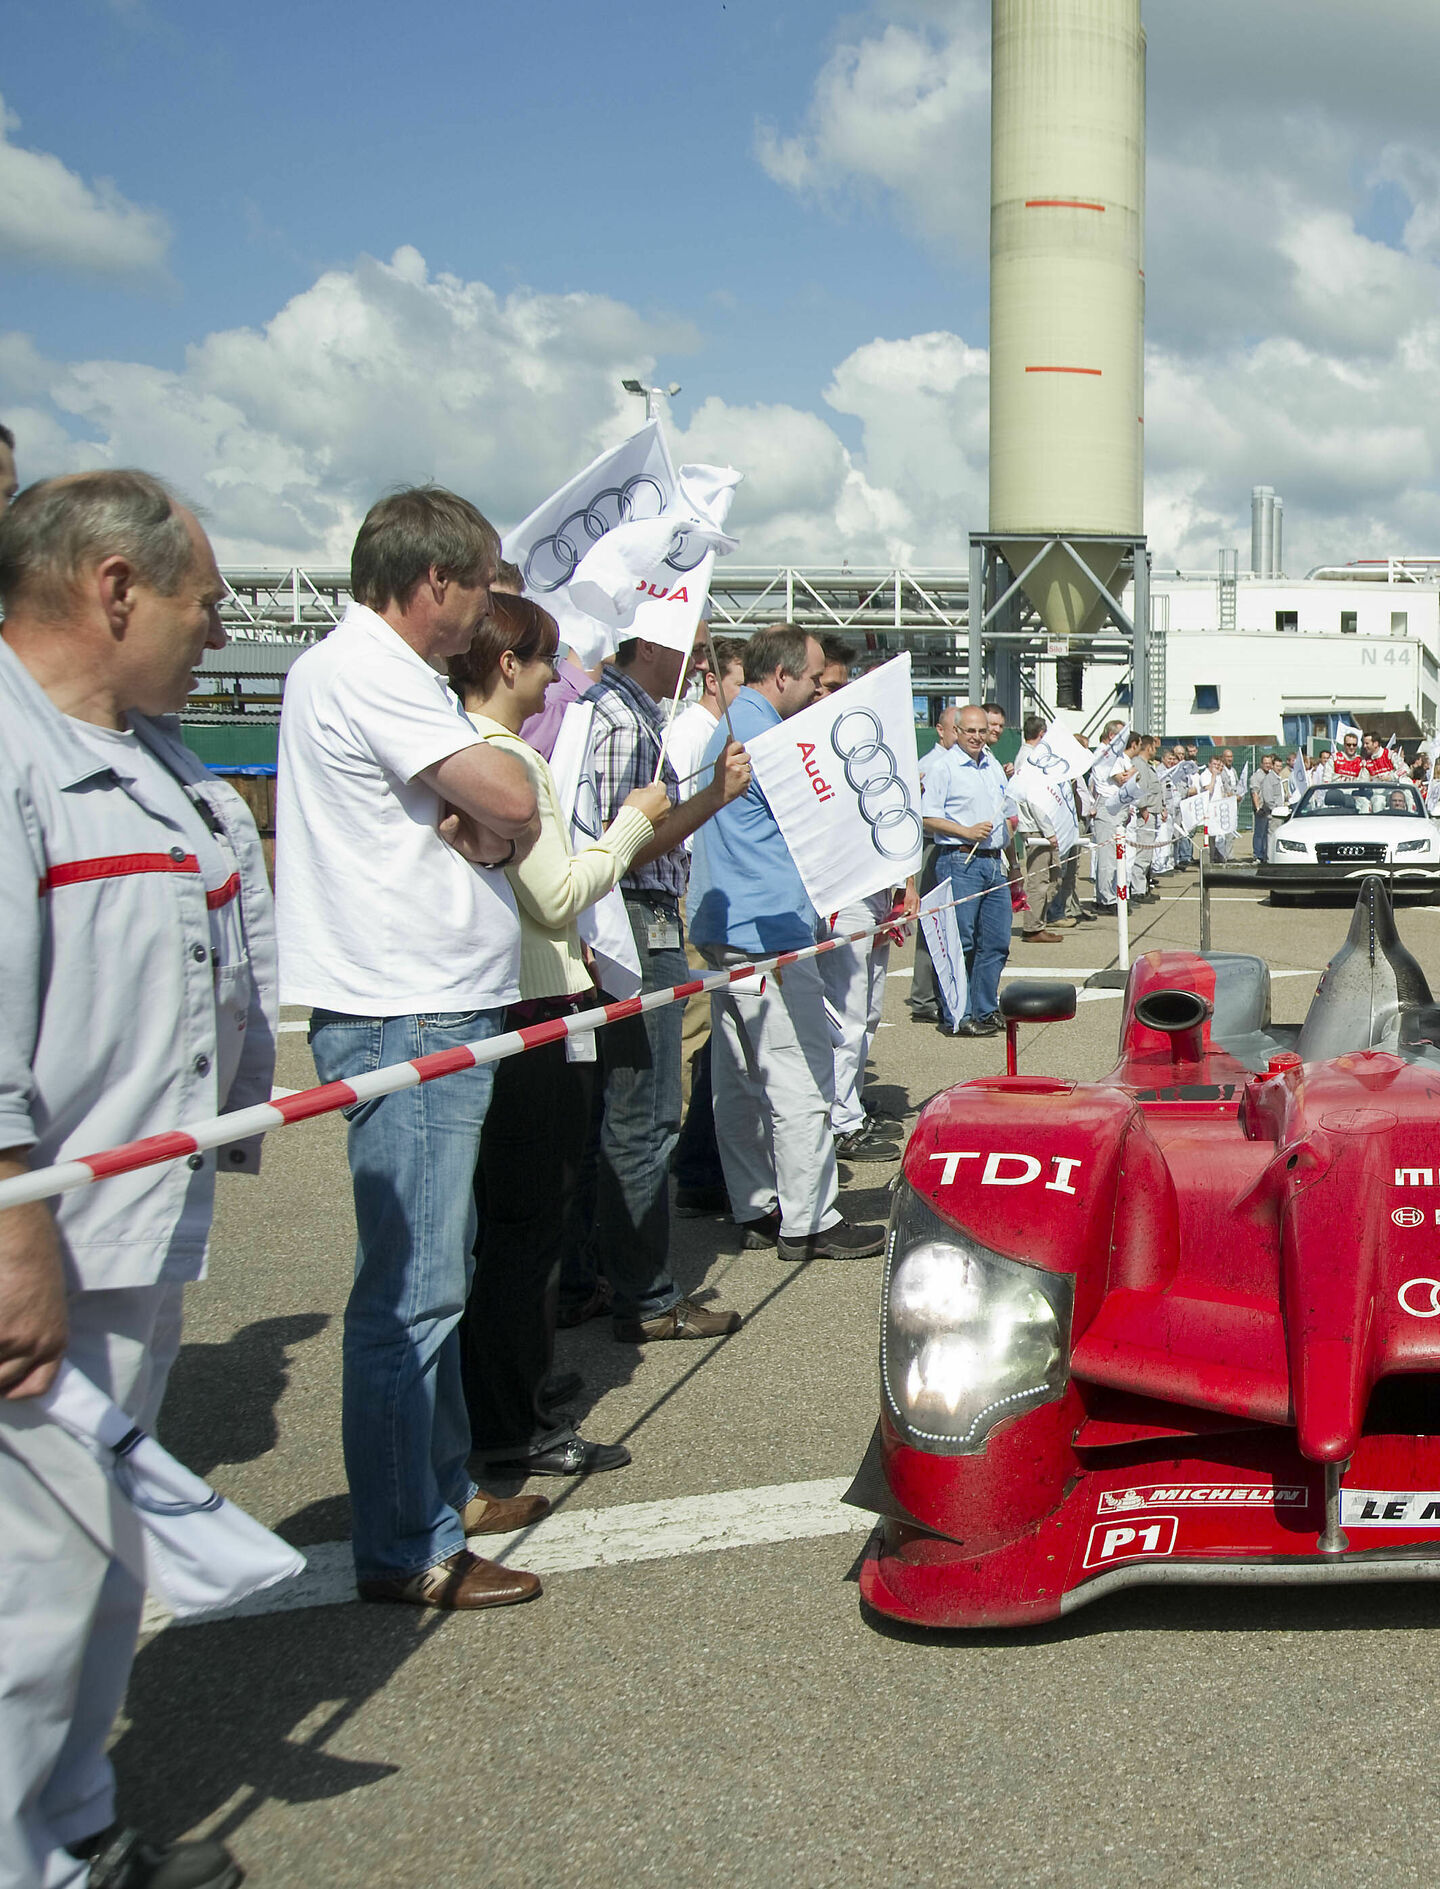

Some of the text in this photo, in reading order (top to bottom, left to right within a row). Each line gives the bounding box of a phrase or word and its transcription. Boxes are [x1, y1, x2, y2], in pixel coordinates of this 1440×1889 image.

[1362, 648, 1410, 664] N 44
[797, 743, 835, 802] Audi
[929, 1152, 1082, 1195] TDI
[1149, 1489, 1299, 1500] MICHELIN
[1360, 1501, 1407, 1519] LE
[1101, 1525, 1161, 1557] P1
